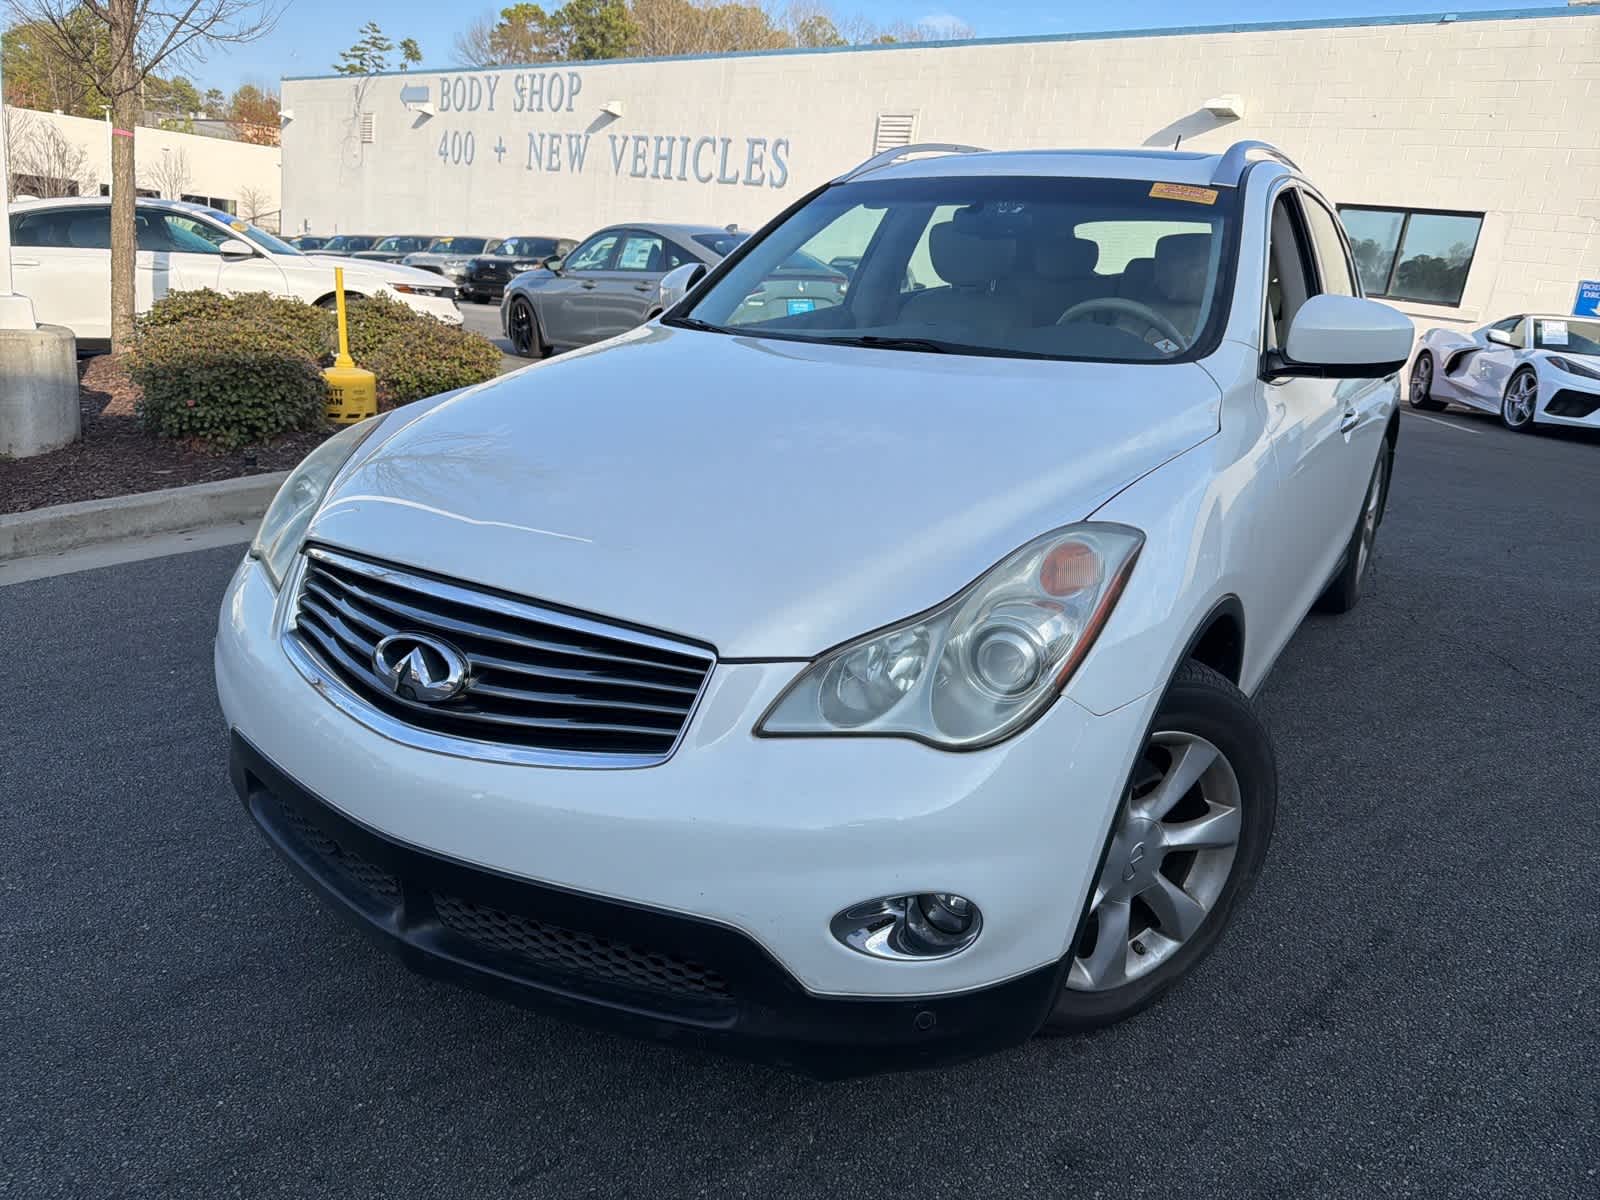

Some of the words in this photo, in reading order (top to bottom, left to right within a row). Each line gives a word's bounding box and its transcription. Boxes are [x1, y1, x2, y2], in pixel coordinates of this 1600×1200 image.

[439, 75, 500, 112] BODY
[513, 71, 582, 112] SHOP
[438, 130, 475, 166] 400
[493, 137, 507, 164] +
[526, 131, 591, 174] NEW
[608, 133, 790, 189] VEHICLES
